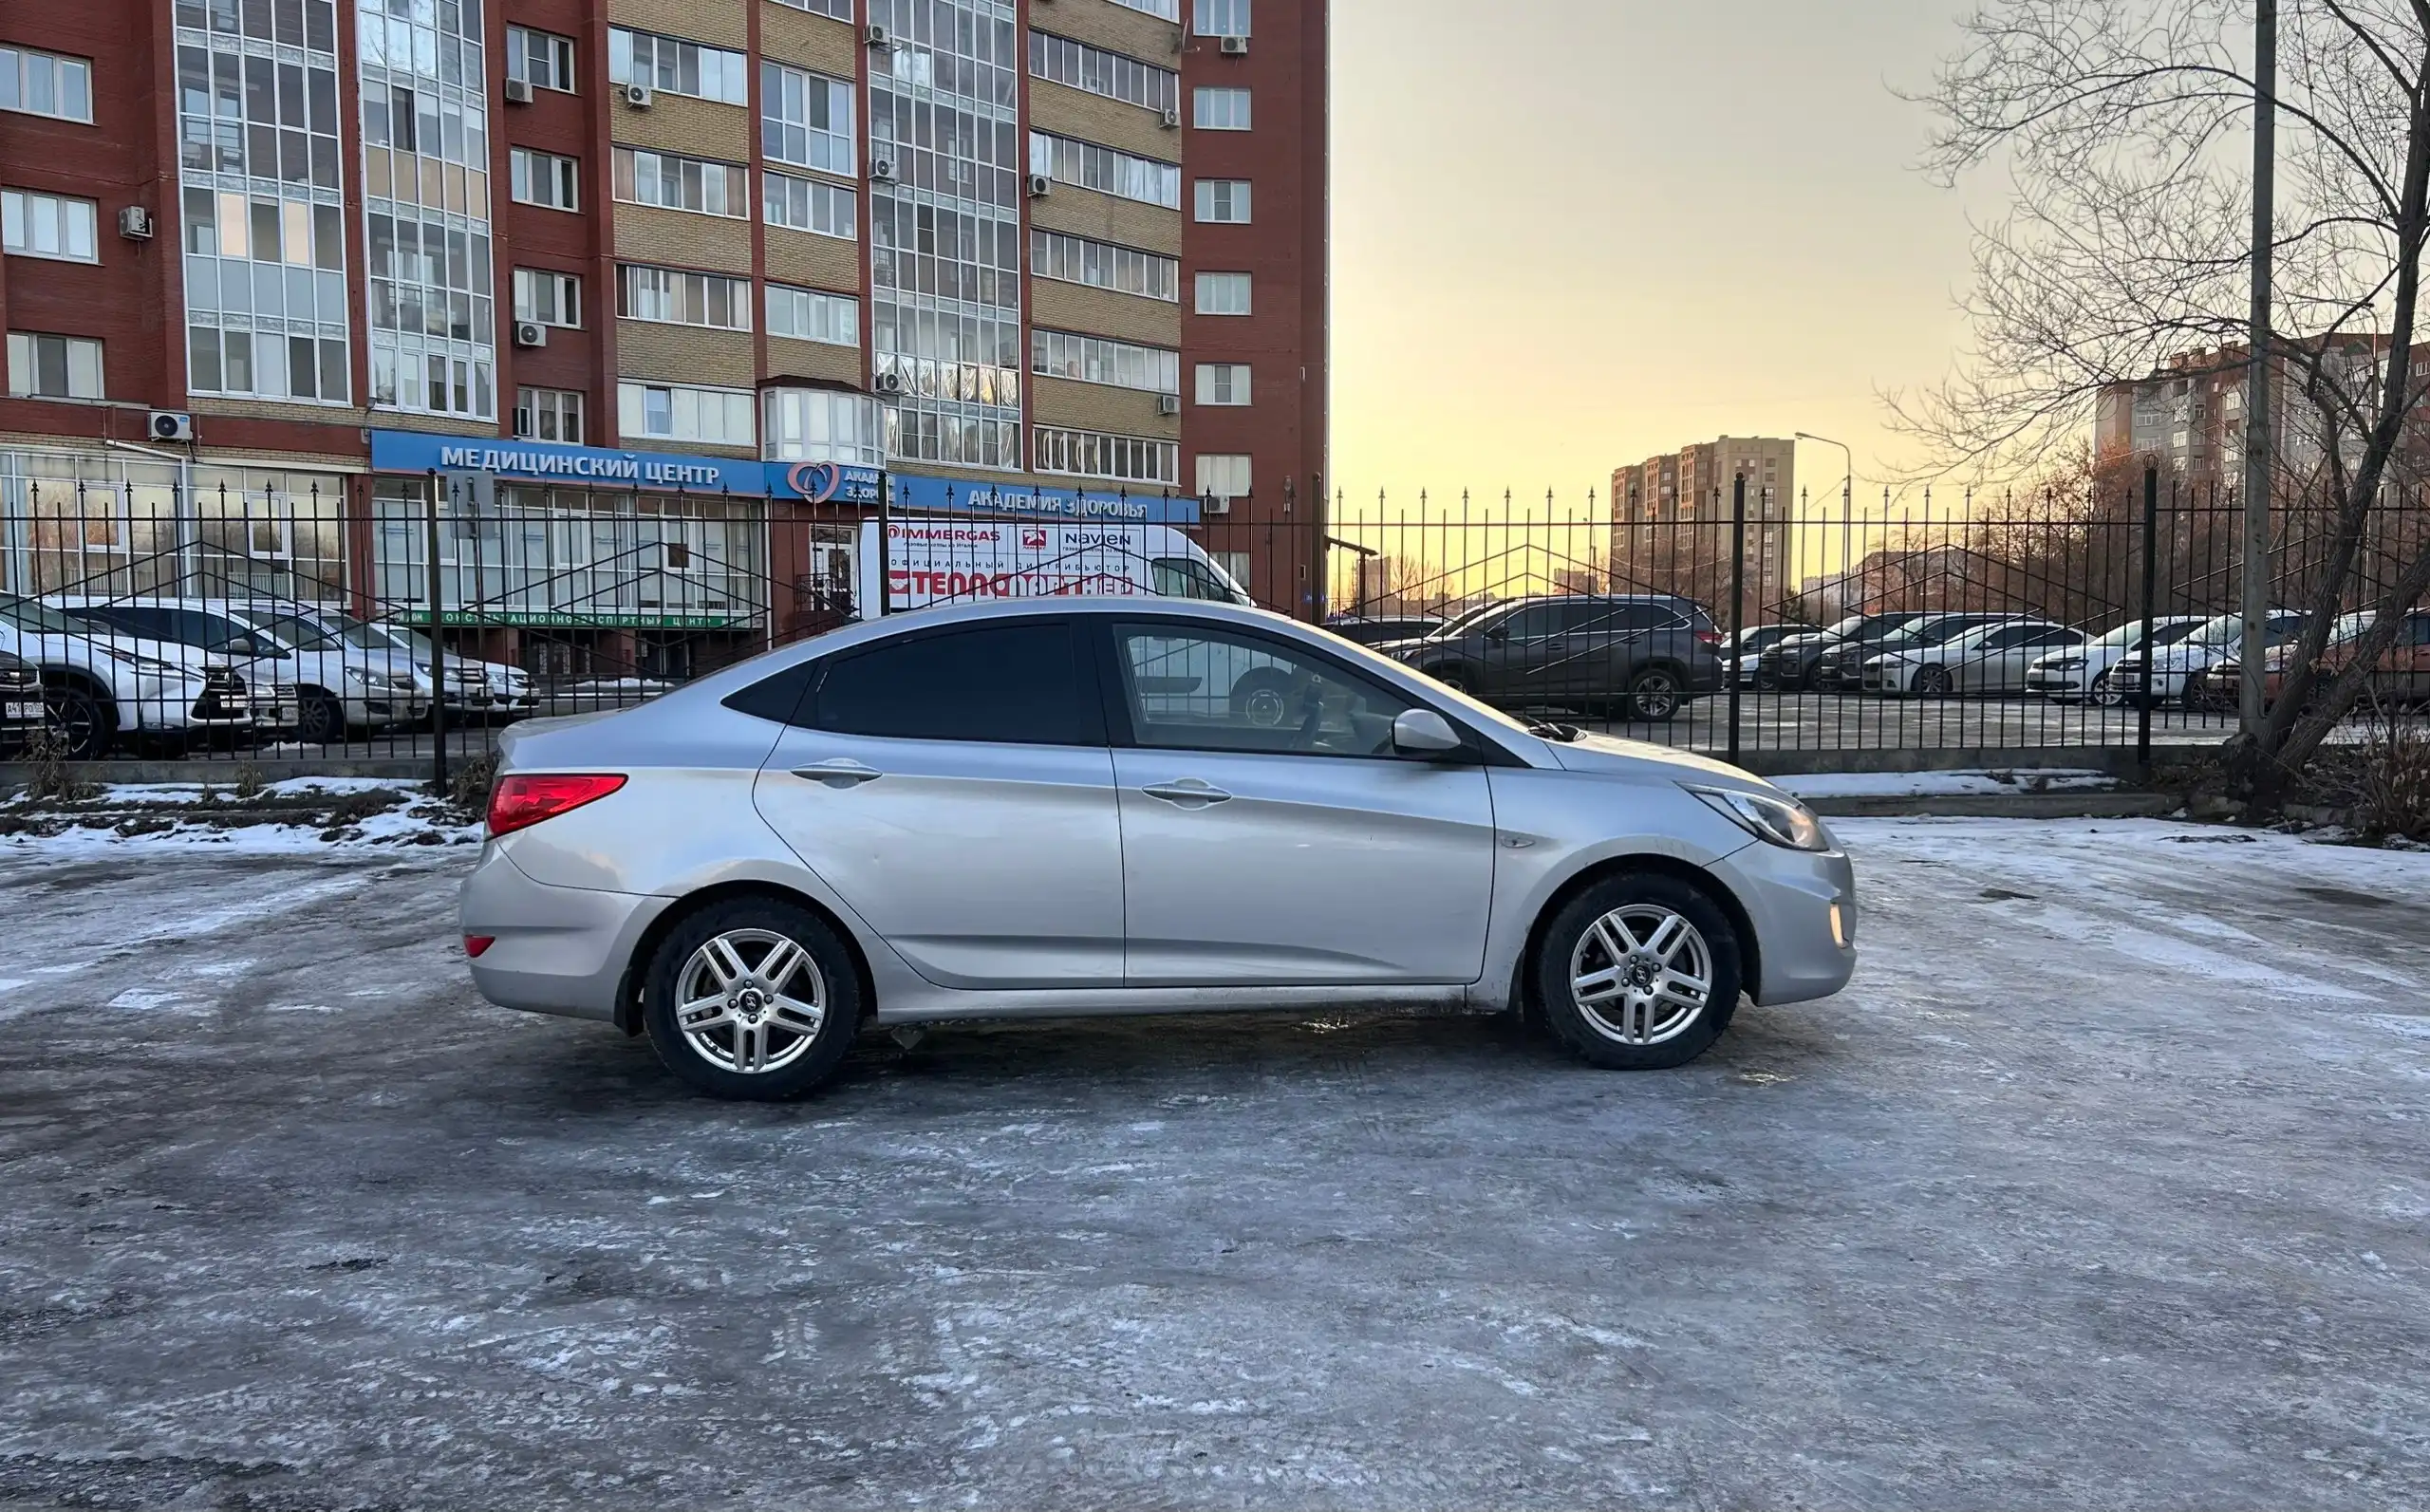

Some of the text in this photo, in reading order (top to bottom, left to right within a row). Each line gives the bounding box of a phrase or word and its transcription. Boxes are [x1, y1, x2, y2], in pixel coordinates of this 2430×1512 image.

[440, 446, 720, 485] МЕДИЦИНСКИЙ ЦЕНТР
[967, 490, 1148, 518] АКАДЕМИЯ ЗДОРОВЬЯ
[902, 528, 1000, 541] IMMERGAS
[890, 558, 1131, 572] ОФИЦИАЛЬНЫЙ ДИТРИБЬЮТОР
[911, 570, 1133, 597] ТЕПЛОПАРТНЕР
[672, 617, 711, 627] ЦНТР
